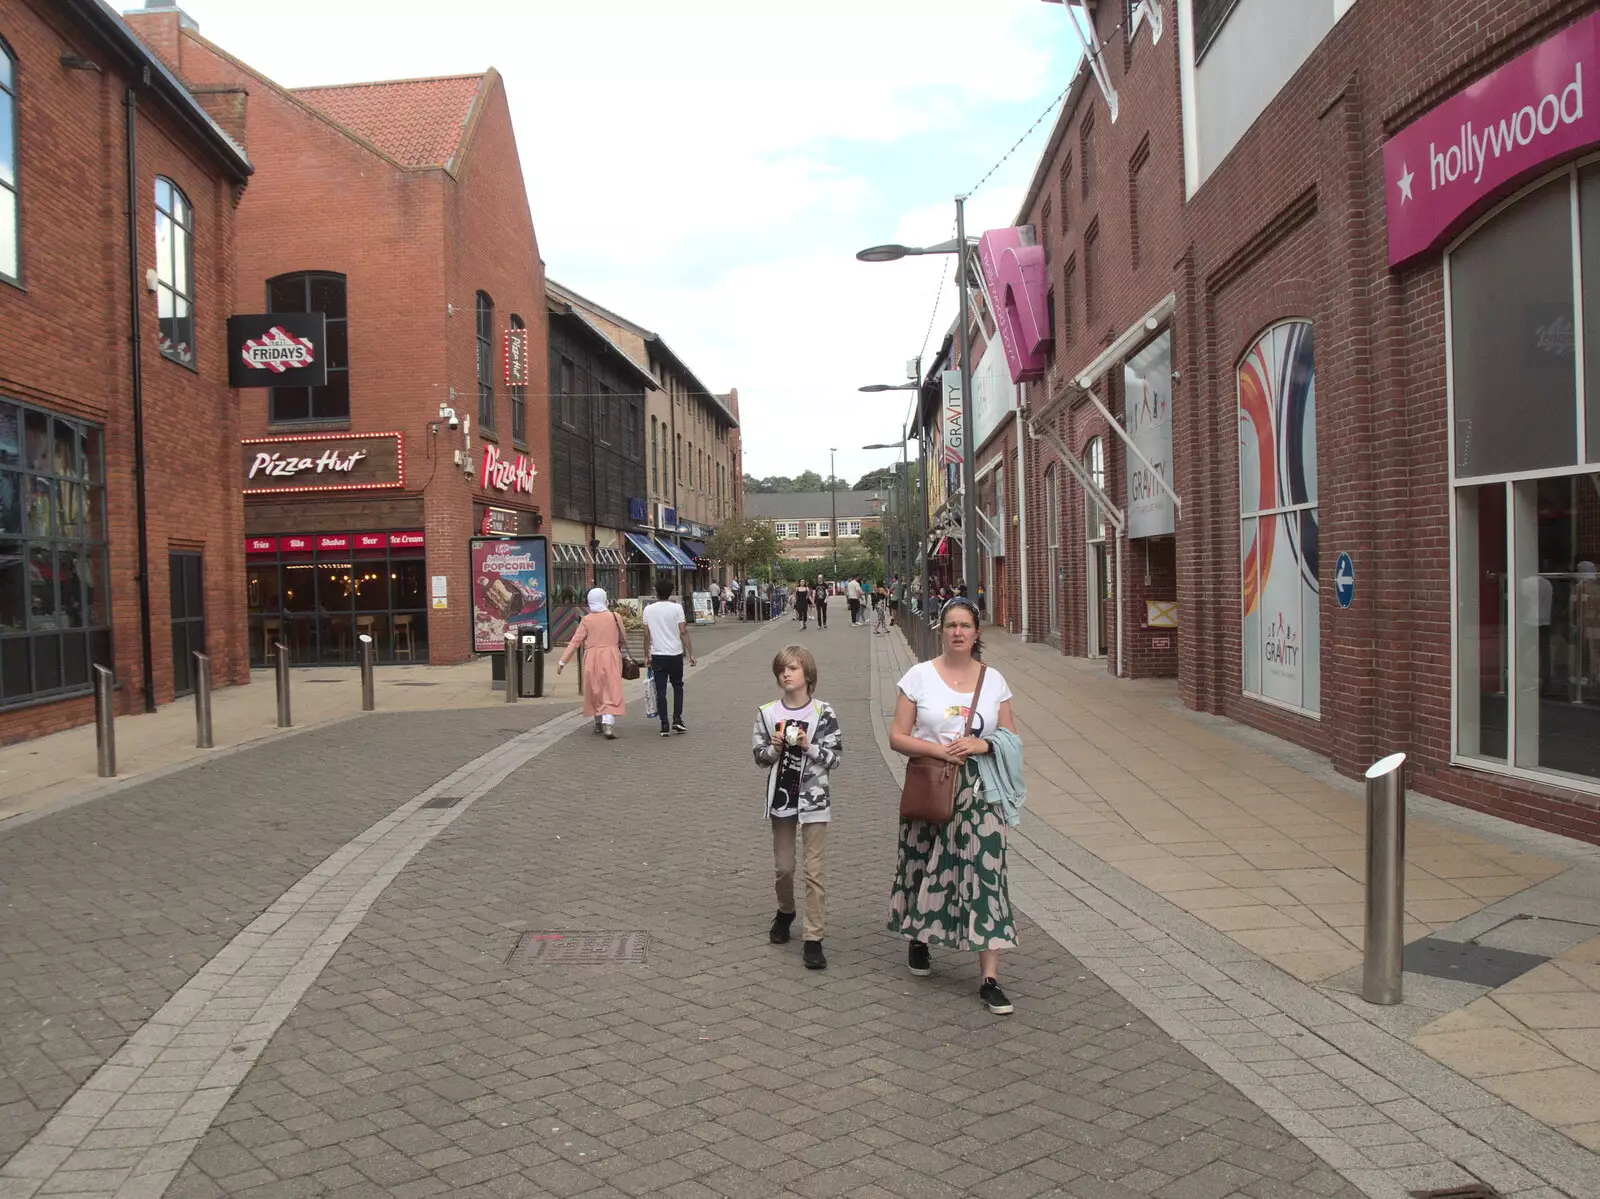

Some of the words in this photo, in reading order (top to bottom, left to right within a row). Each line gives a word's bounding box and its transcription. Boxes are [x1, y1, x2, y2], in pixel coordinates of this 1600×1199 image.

[1430, 62, 1583, 191] hollywood
[511, 335, 521, 360] Pizza
[513, 360, 522, 379] Hut
[946, 384, 964, 448] GRAVITY
[248, 452, 314, 479] Pizza
[316, 449, 366, 474] Hut
[483, 444, 516, 491] Pizza
[515, 454, 538, 494] Hut
[321, 538, 346, 547] Shakes
[362, 536, 378, 545] Beer
[390, 535, 401, 544] Ice
[401, 534, 424, 543] Cream
[483, 562, 535, 571] POPCORN
[1265, 639, 1299, 666] GRAVITY
